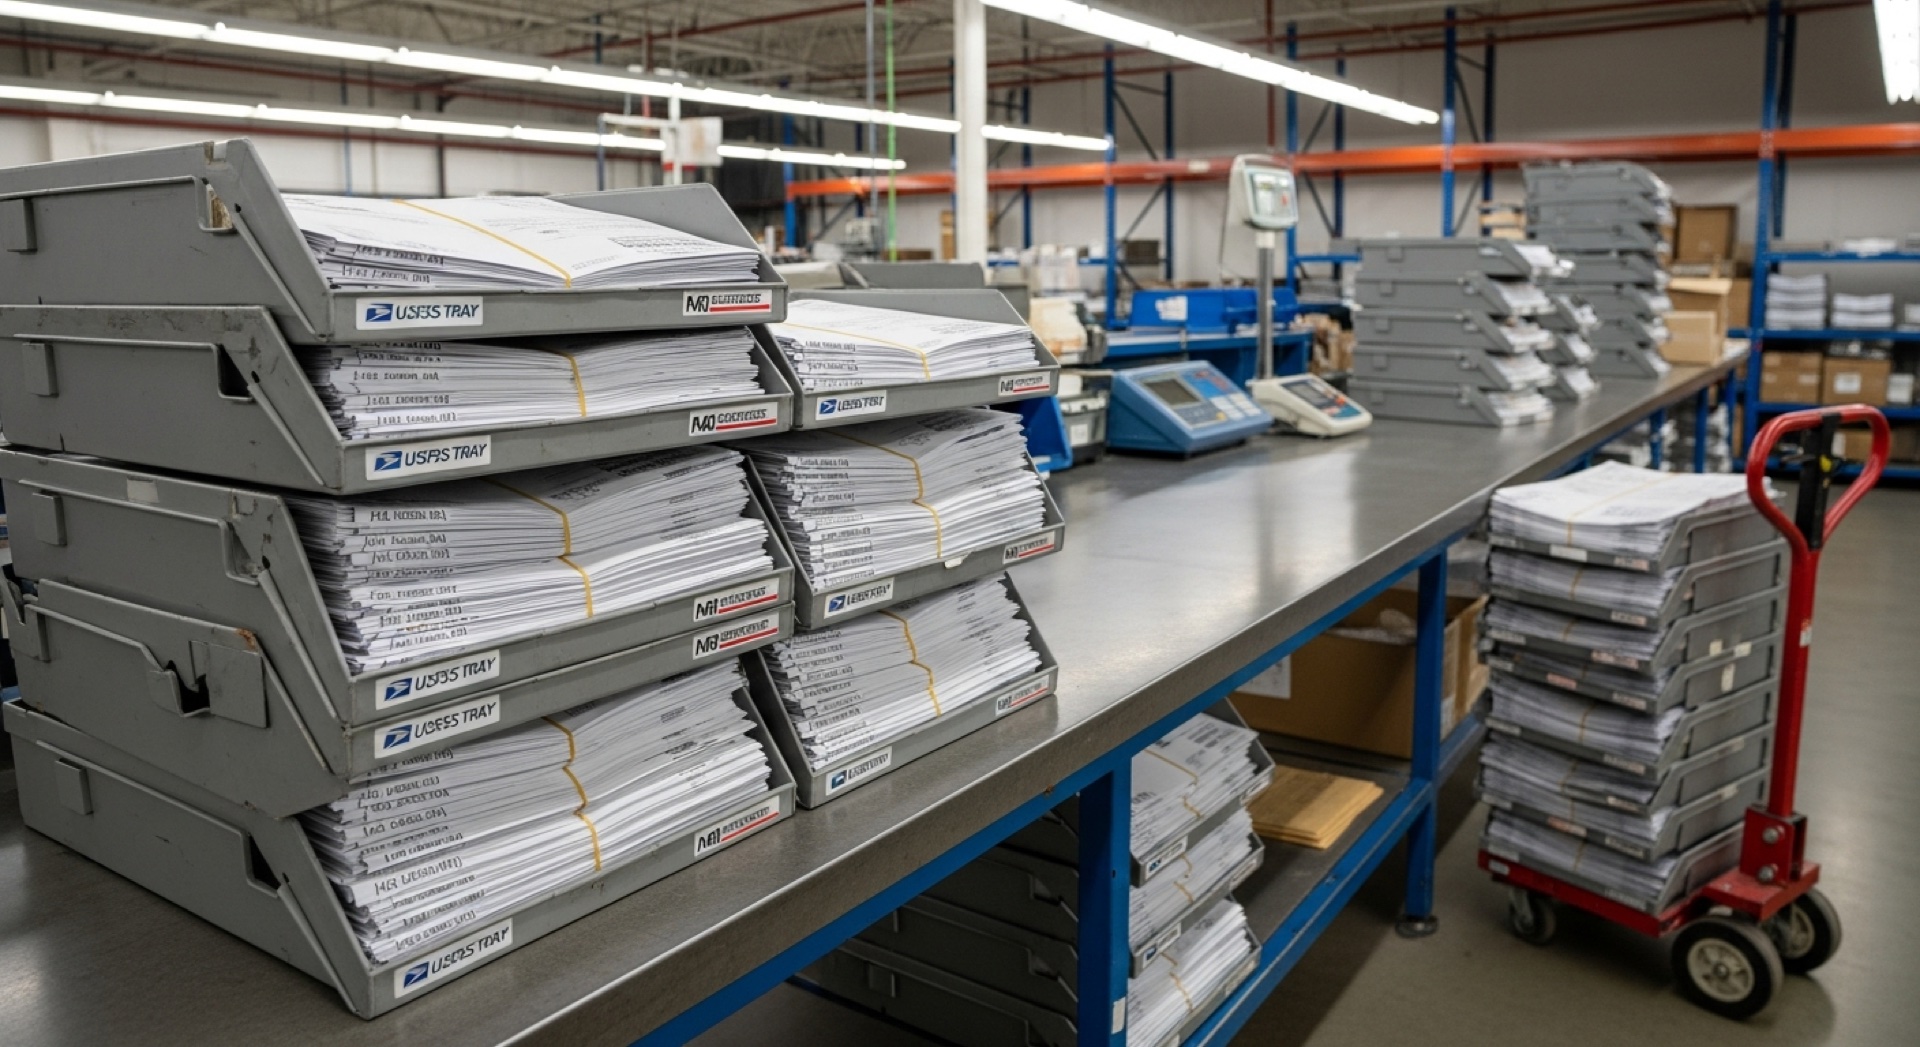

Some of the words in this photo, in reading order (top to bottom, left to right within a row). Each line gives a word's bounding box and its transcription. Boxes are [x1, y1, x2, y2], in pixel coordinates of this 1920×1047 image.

[443, 304, 480, 318] TRAY
[452, 443, 488, 460] TRAY
[461, 702, 497, 724] TRAY
